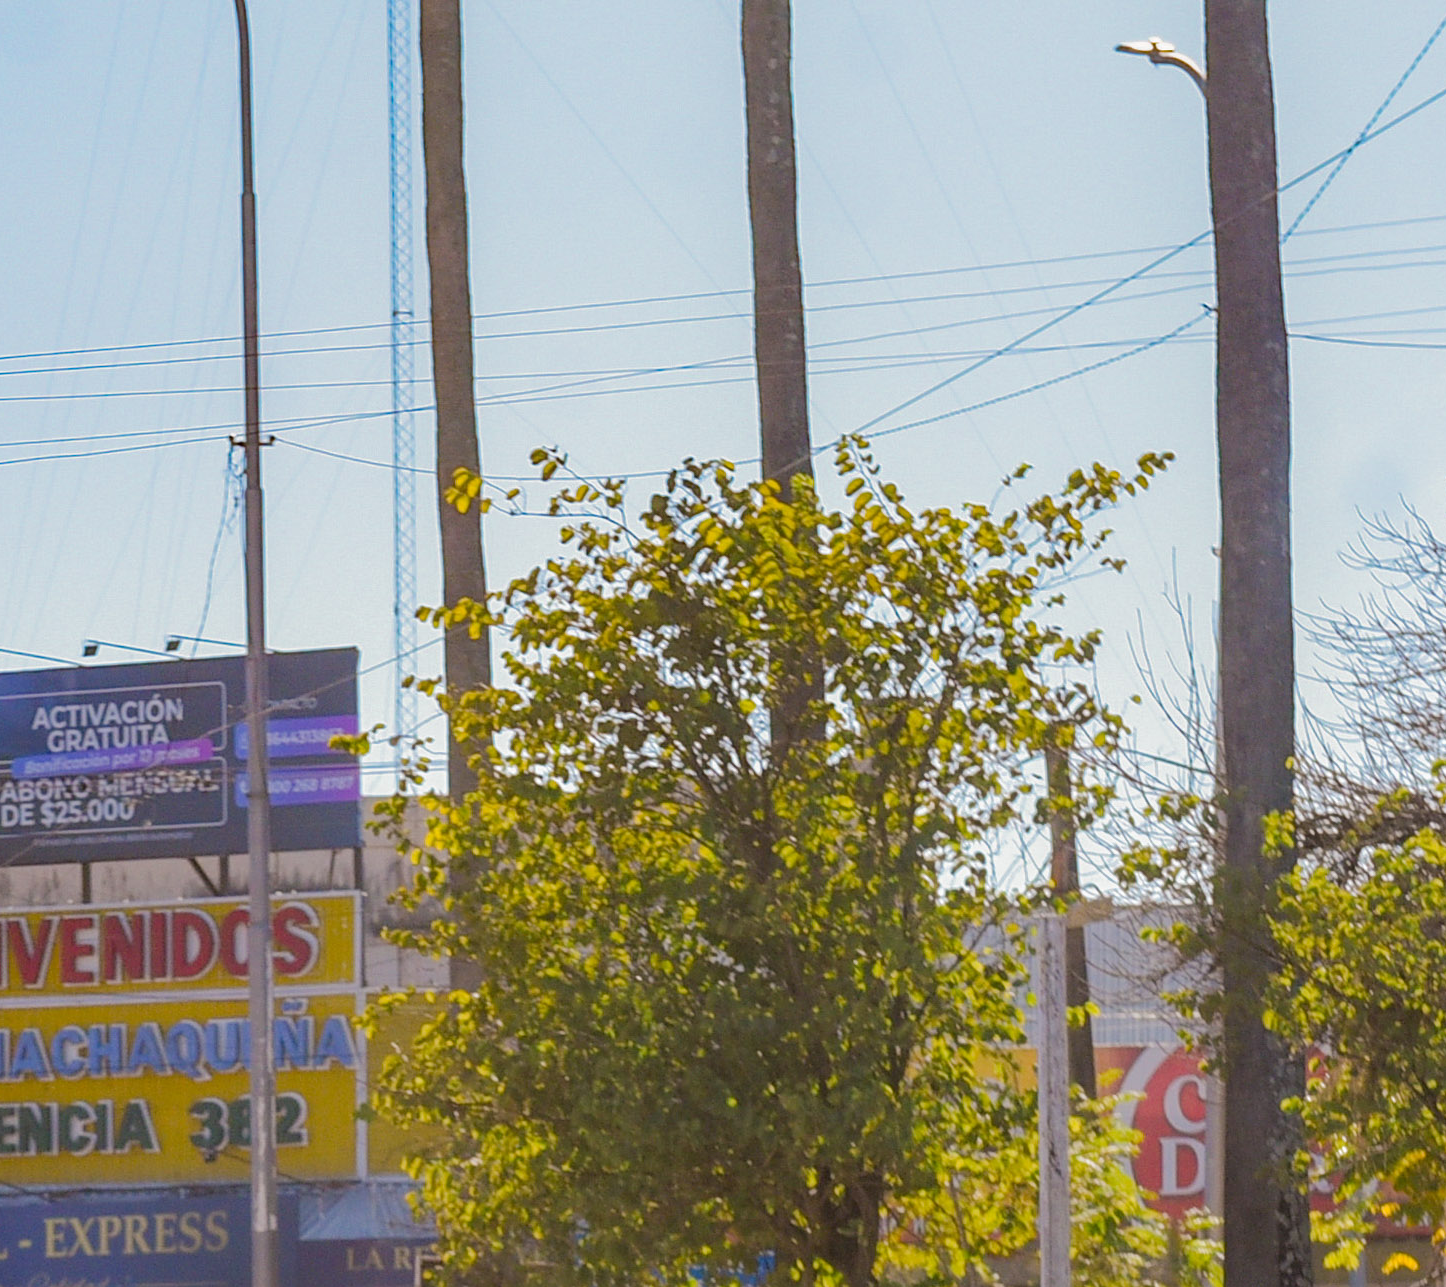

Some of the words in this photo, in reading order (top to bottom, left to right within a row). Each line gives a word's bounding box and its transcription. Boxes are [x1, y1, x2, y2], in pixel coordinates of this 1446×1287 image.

[32, 693, 184, 730] ACTIVACIÓN
[47, 724, 170, 752] GRATUITA
[0, 774, 92, 803] ABONO
[98, 768, 220, 797] MENSUAL
[0, 803, 36, 828] DE
[40, 798, 136, 828] $25.000
[189, 1091, 309, 1152] 382
[44, 1210, 230, 1259] EXPRESS
[346, 1246, 385, 1271] LA
